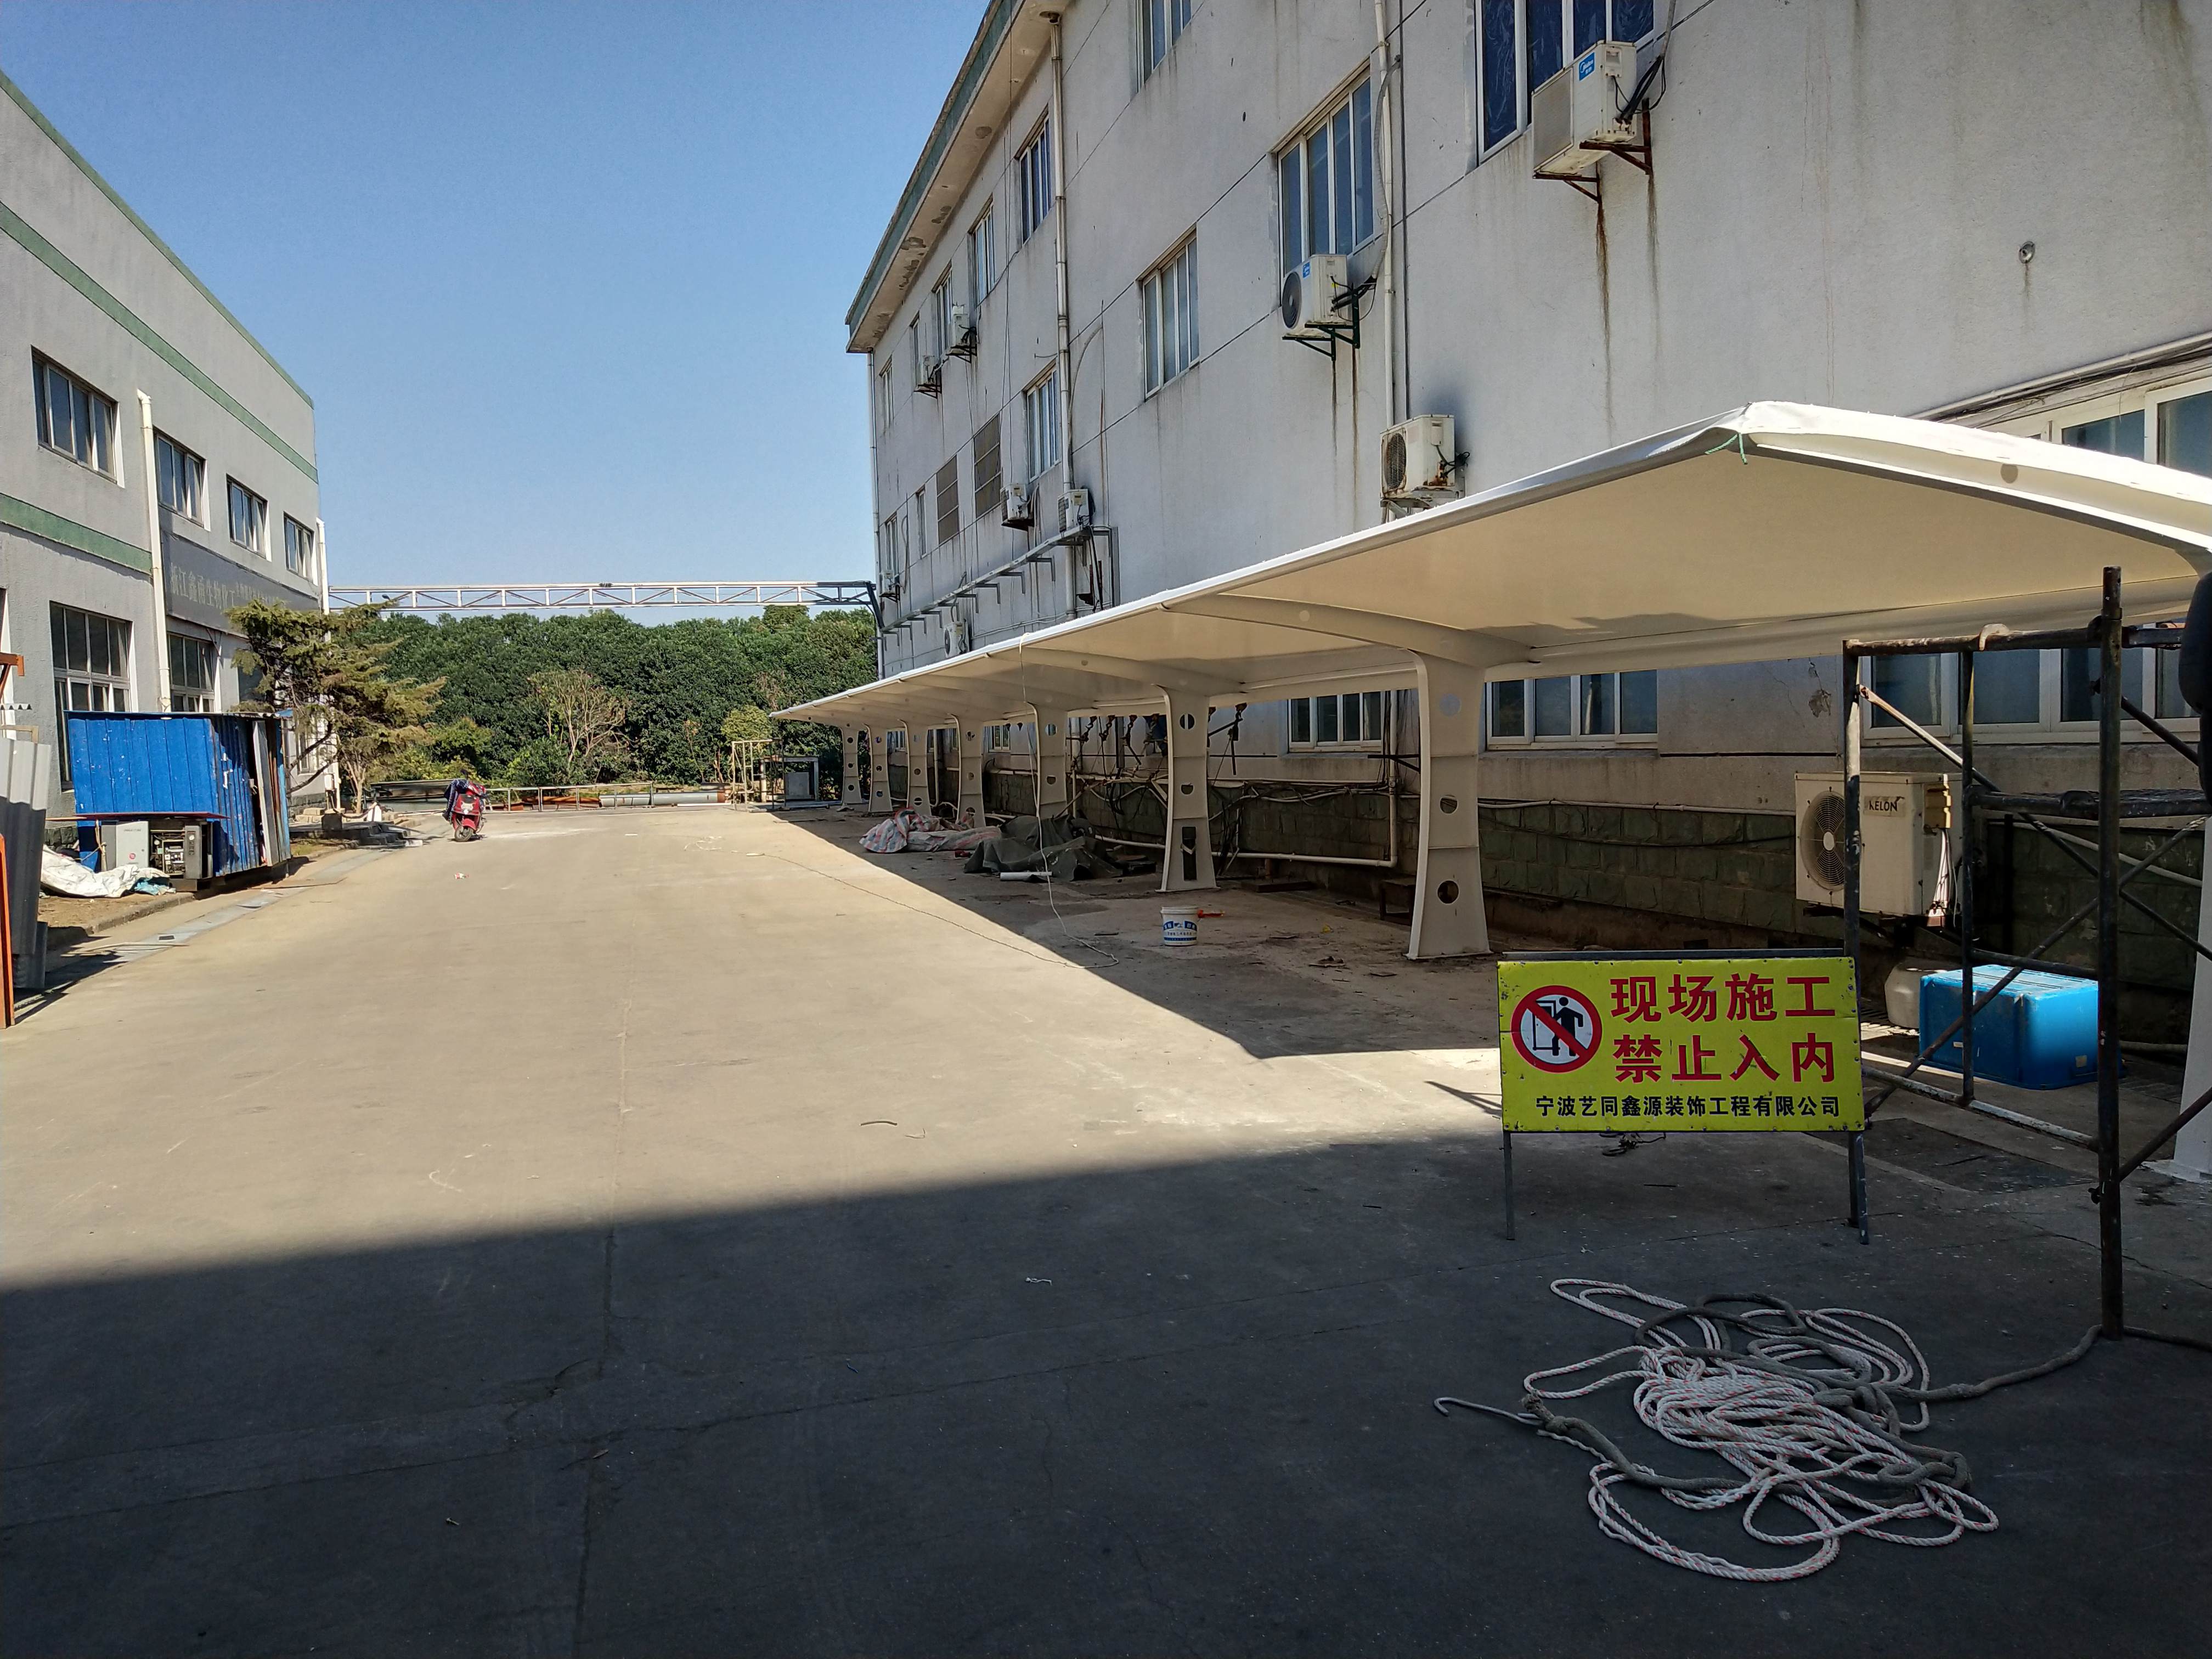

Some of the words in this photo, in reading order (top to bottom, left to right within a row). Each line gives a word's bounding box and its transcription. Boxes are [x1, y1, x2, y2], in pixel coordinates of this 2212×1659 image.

[1611, 973, 1836, 1023] 现场施工
[1612, 1032, 1836, 1084] 禁止入内
[1536, 1096, 1839, 1117] 宁波艺同鑫源装饰工程有限公司
